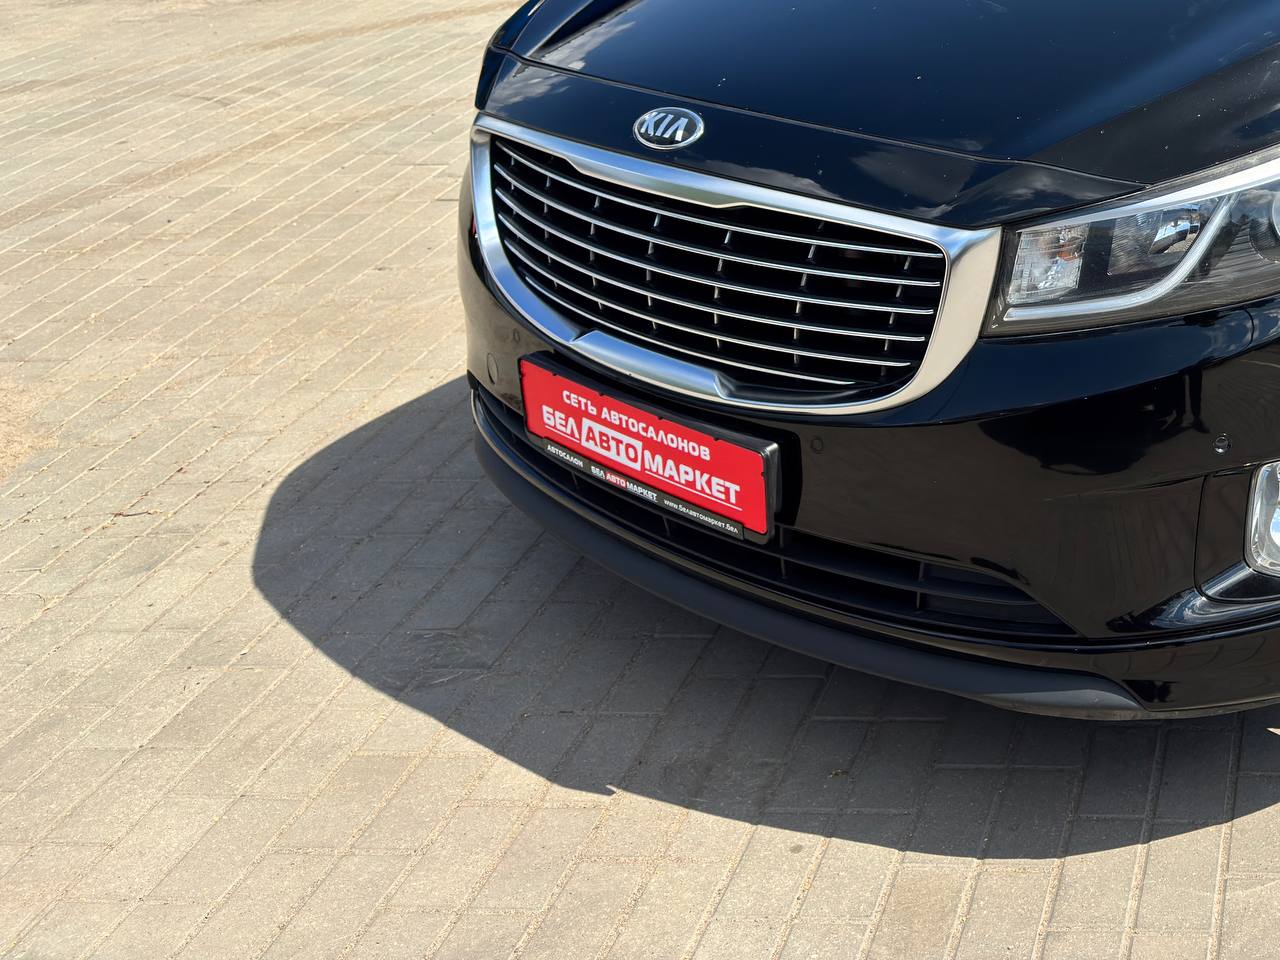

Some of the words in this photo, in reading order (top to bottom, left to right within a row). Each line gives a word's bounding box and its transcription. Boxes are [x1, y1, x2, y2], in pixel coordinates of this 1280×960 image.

[640, 112, 689, 142] KIA
[542, 405, 580, 439] БЕЛ
[585, 427, 639, 463] АВТО
[645, 449, 741, 505] МАРКЕТ
[563, 390, 597, 416] СЕТЬ
[601, 407, 711, 461] АВТОСАЛОНОВ
[546, 444, 583, 468] АВТОСАЛОН
[590, 465, 605, 480] БЕЛ
[606, 473, 626, 488] АВТО
[626, 481, 658, 502] МАРКЕТ
